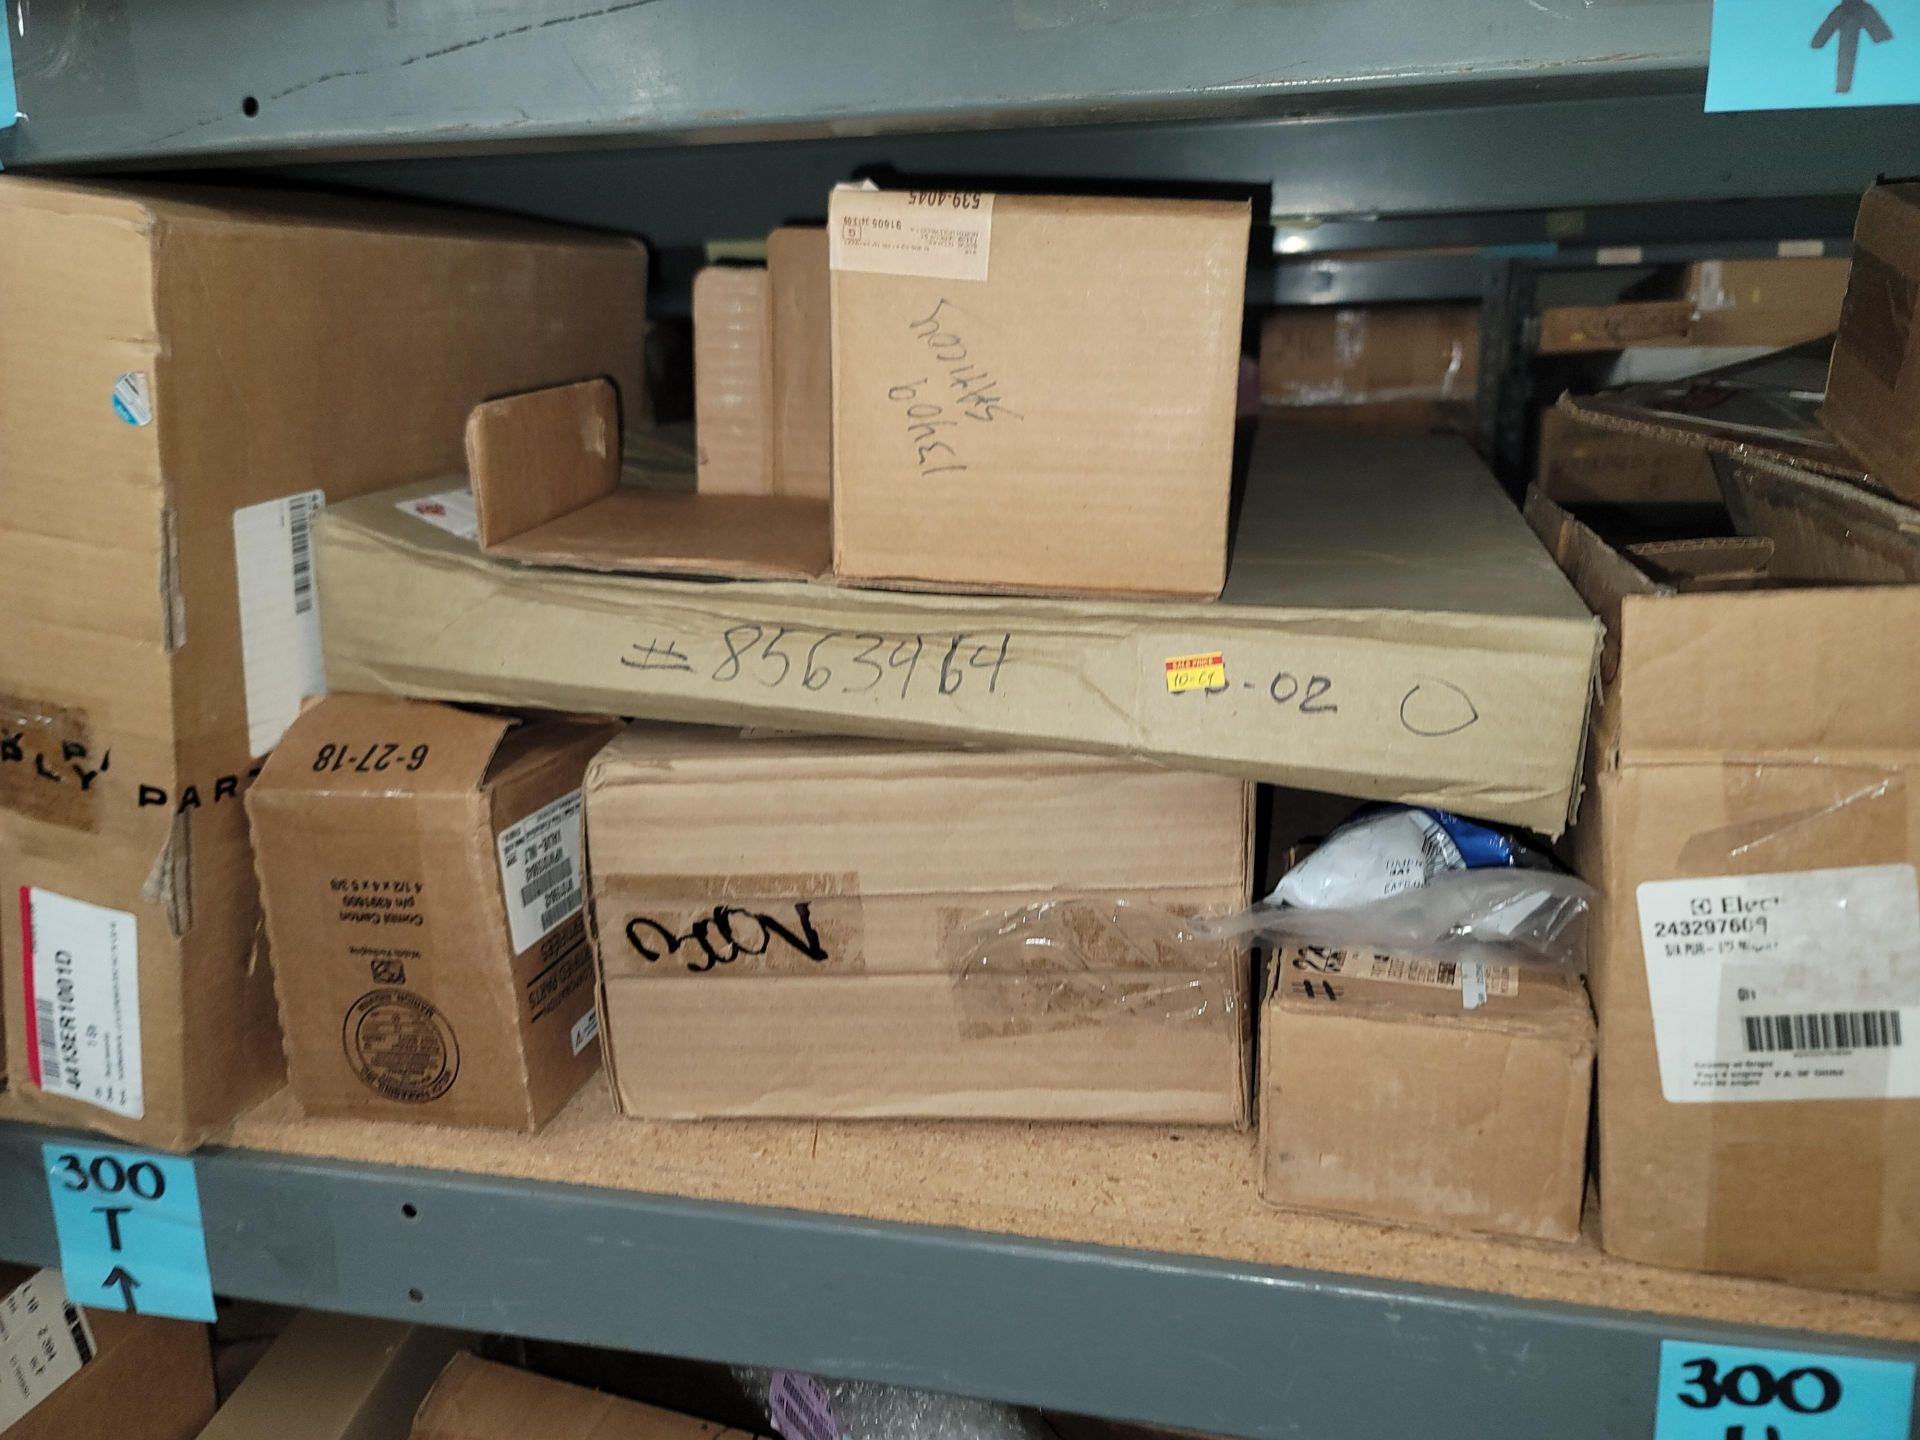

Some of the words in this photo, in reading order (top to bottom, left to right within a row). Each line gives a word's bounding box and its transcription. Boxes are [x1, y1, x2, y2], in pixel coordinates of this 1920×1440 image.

[313, 742, 431, 773] 6-27-18
[57, 1153, 166, 1201] 300
[91, 1204, 133, 1252] T
[1677, 1357, 1842, 1415] 300
